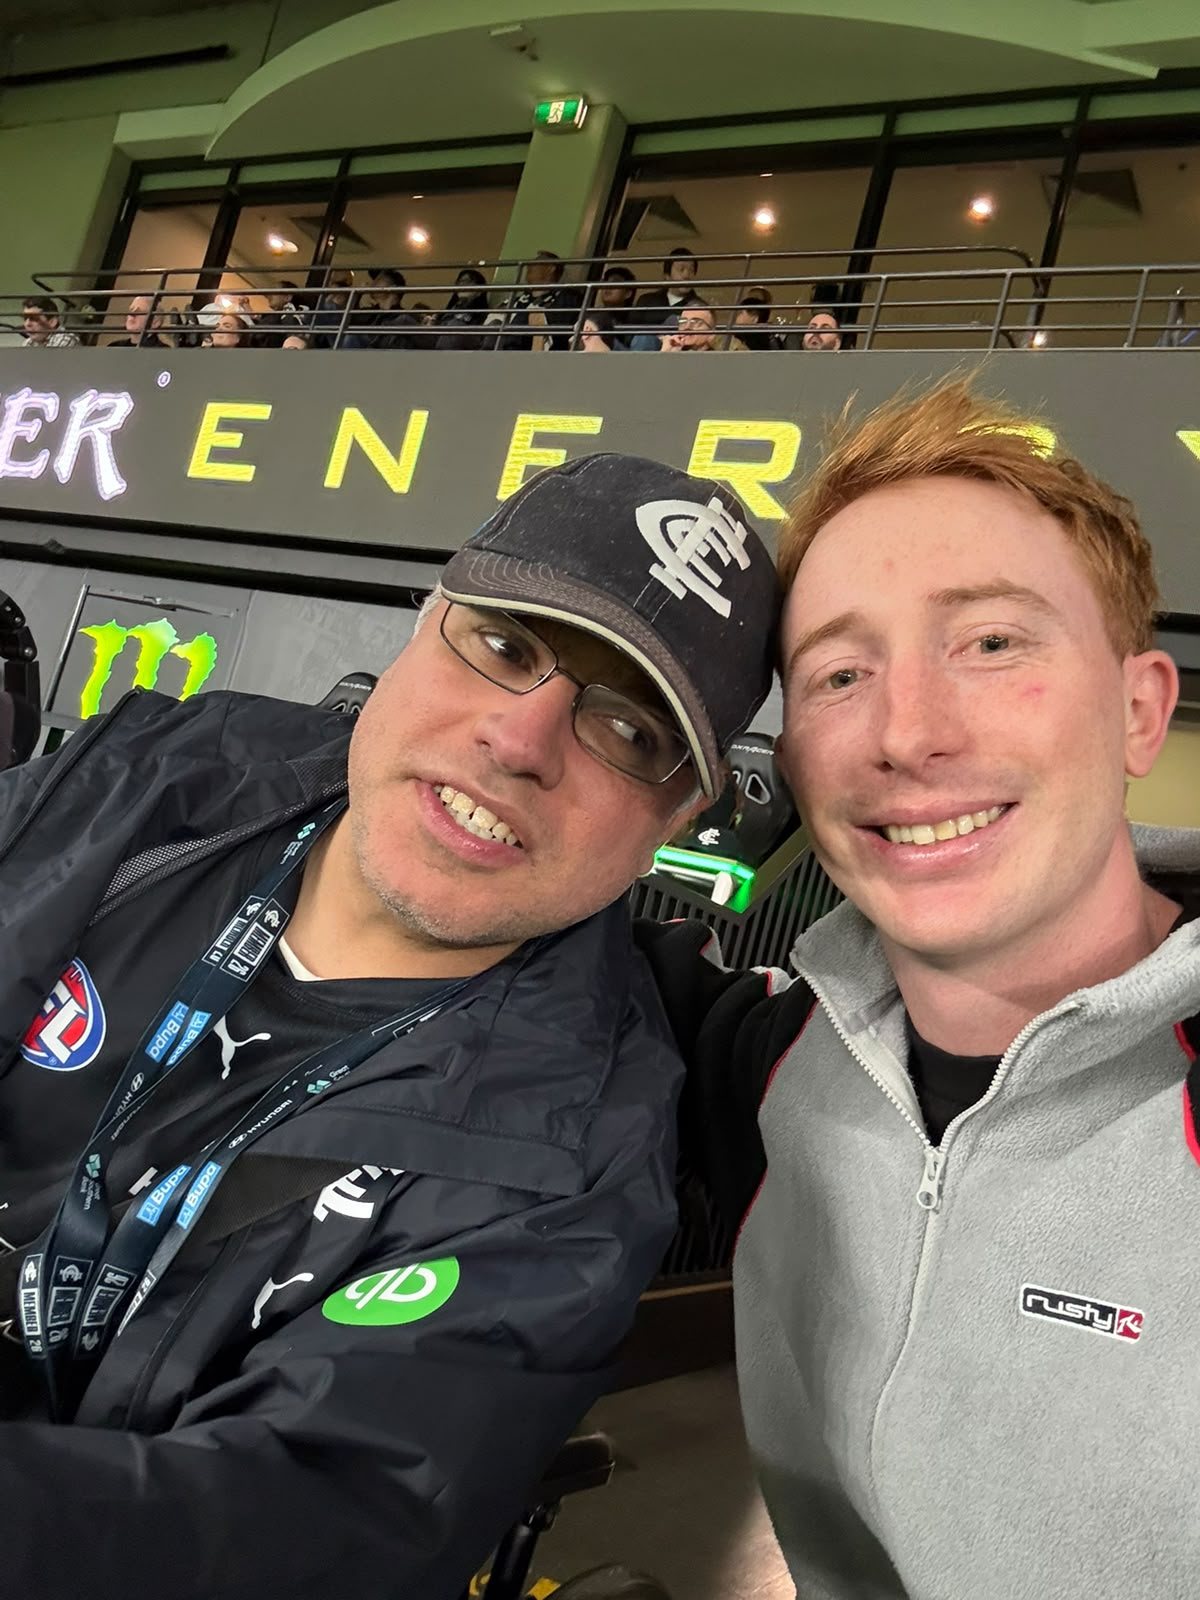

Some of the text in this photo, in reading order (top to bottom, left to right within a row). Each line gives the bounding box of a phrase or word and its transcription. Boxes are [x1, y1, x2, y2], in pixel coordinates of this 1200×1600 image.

[227, 958, 250, 976] 26
[149, 1019, 181, 1059] Bupa
[247, 1099, 293, 1134] HYUNDAI
[187, 1166, 216, 1210] Bupa
[23, 1291, 42, 1353] MEMBER 26
[1025, 1293, 1113, 1331] rusty
